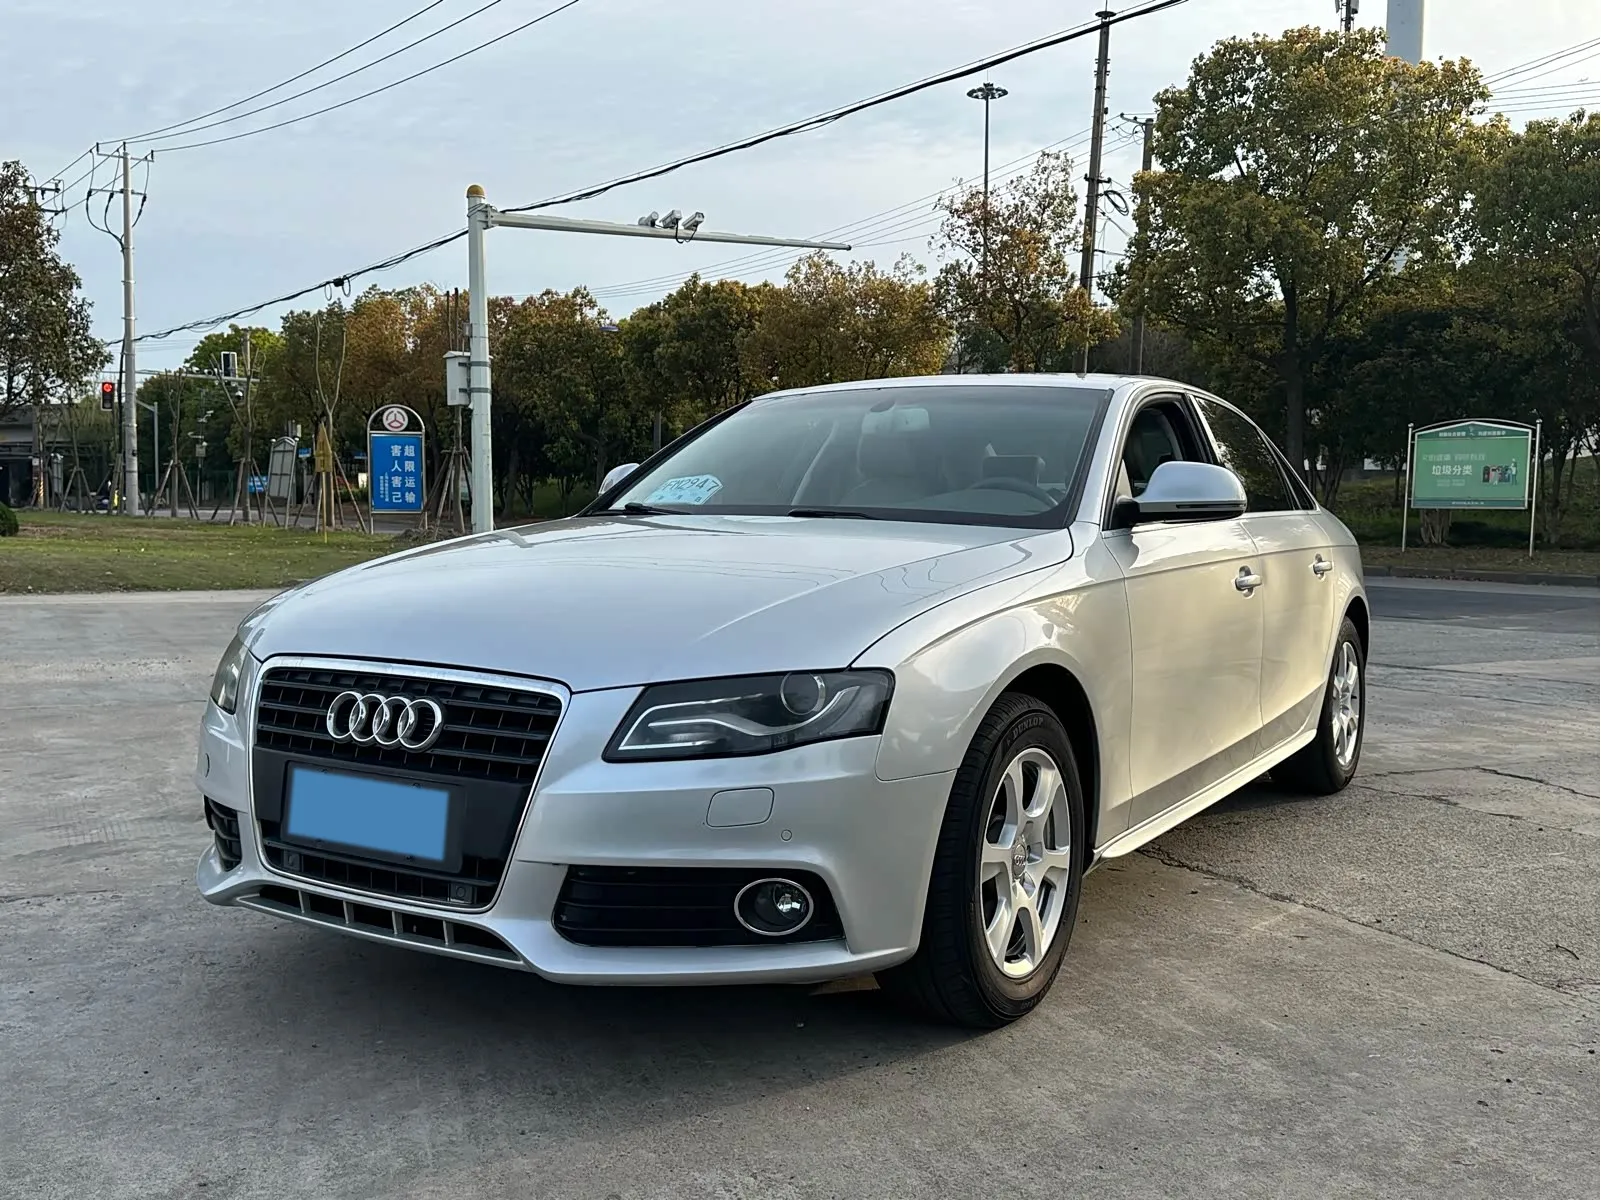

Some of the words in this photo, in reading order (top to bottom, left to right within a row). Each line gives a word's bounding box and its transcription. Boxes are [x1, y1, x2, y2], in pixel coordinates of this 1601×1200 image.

[391, 444, 402, 503] 害人害己
[403, 444, 416, 504] 超限运输
[1431, 464, 1473, 476] 垃圾分类
[1012, 717, 1045, 740] DUNLOP
